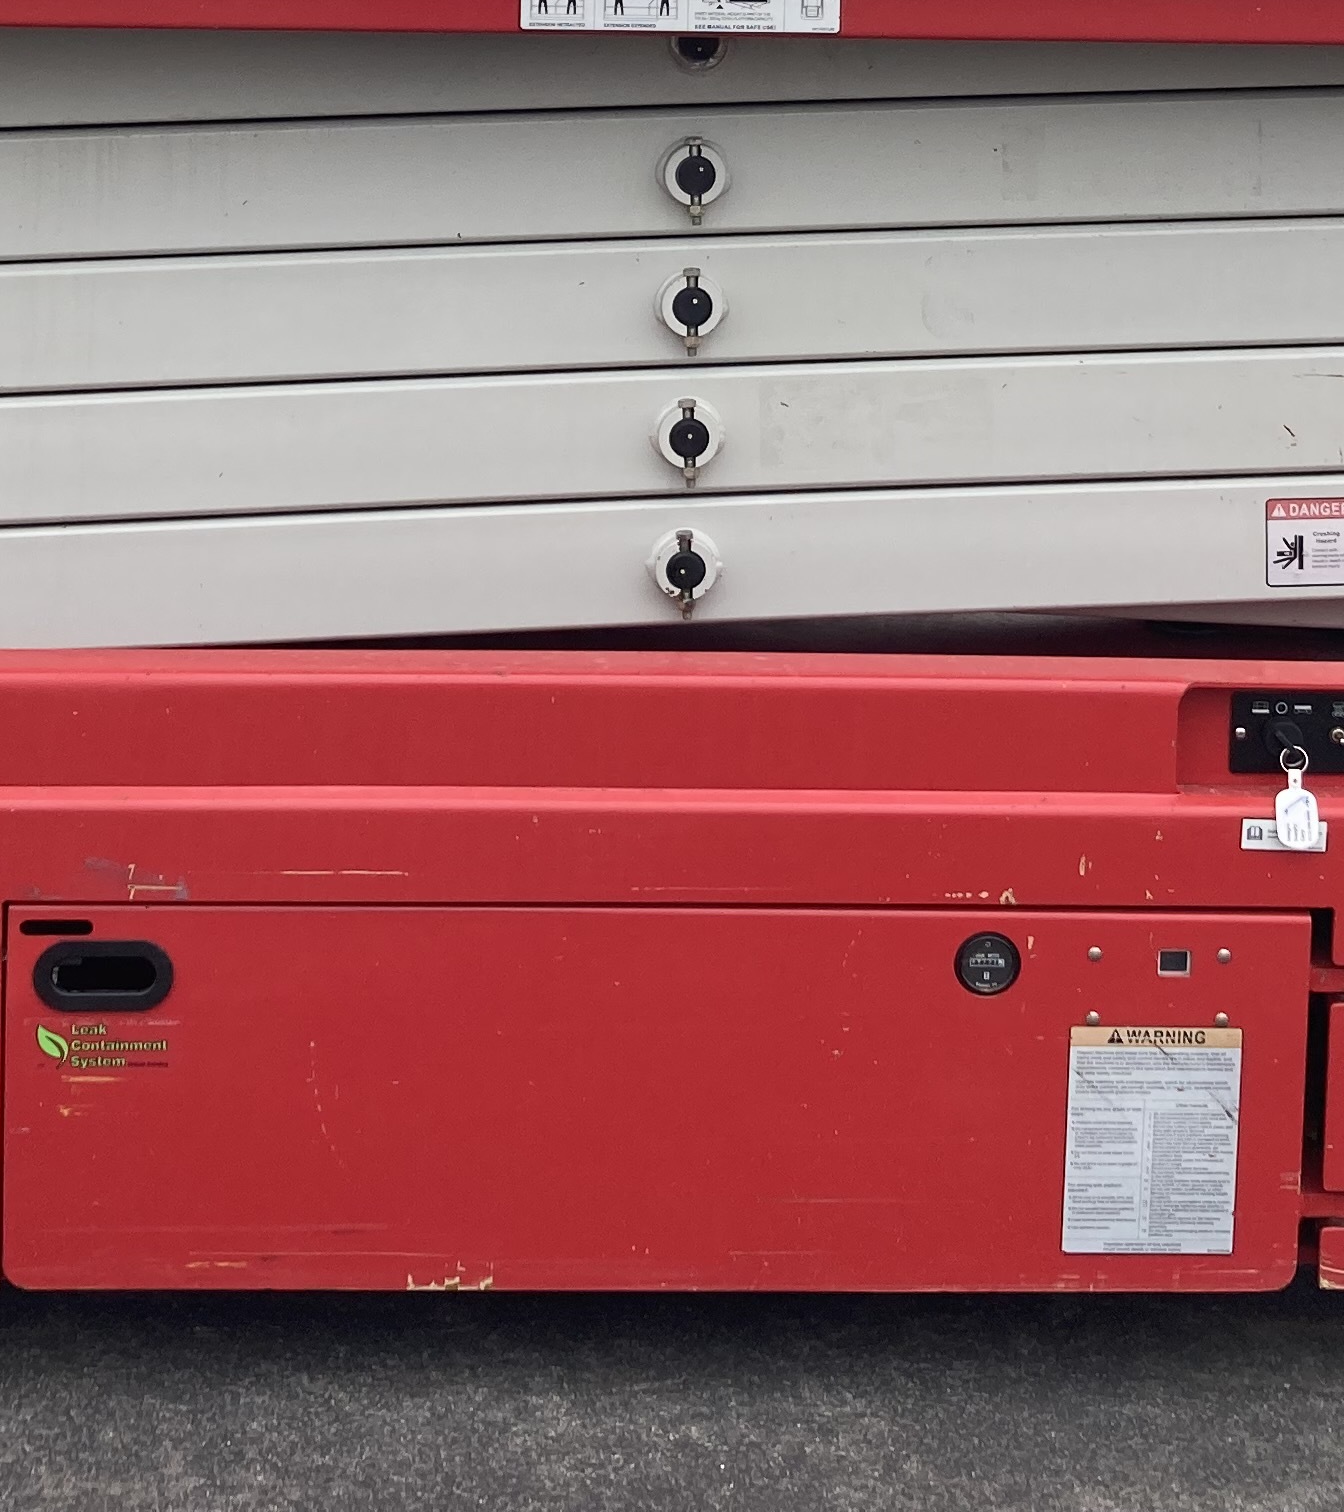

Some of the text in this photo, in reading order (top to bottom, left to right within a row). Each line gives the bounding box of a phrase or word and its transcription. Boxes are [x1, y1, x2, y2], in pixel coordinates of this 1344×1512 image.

[70, 1023, 107, 1036] Leak
[1126, 1029, 1207, 1045] WARNING
[70, 1039, 168, 1051] Containment
[70, 1055, 127, 1069] System
